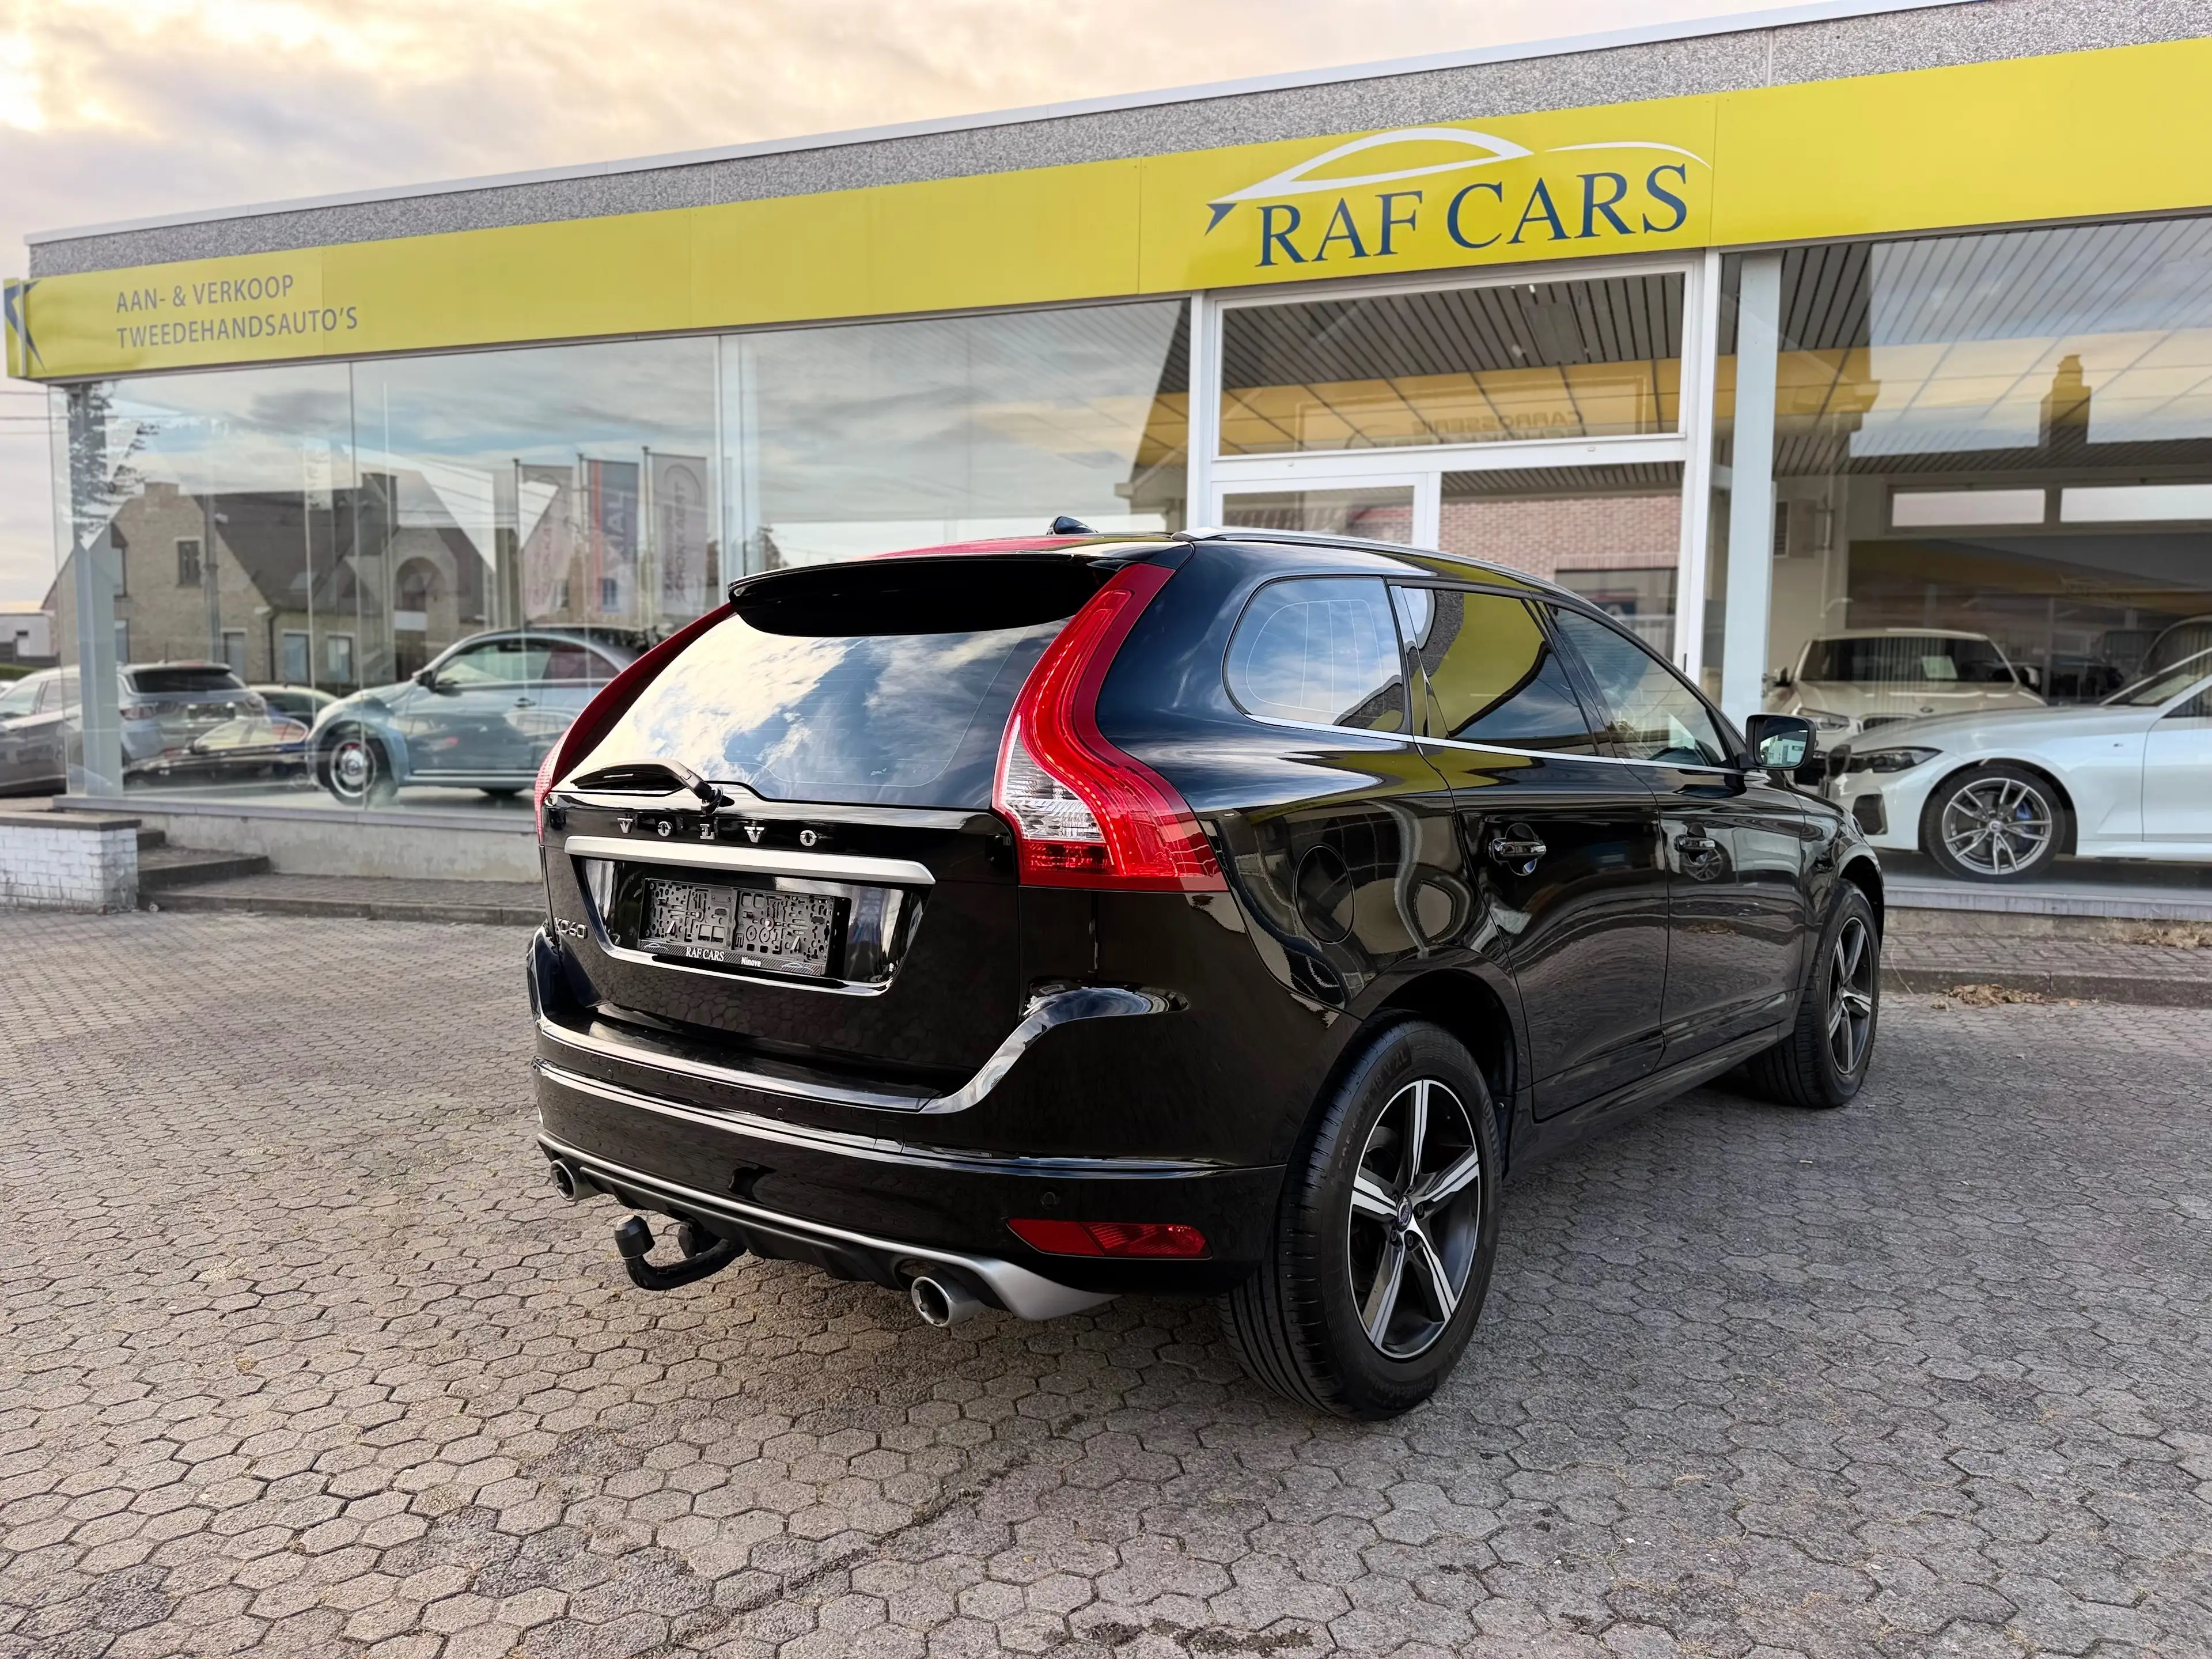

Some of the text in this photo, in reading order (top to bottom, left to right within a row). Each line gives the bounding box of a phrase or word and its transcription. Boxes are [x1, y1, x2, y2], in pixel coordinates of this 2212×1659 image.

[1255, 163, 1687, 267] RAF CARS
[116, 274, 294, 313] AAN- & VERKOOP
[116, 306, 358, 349] TWEEDEHANDSAUTO'S
[617, 817, 817, 847] VOLVO
[685, 946, 762, 967] RAF CARS Ninove
